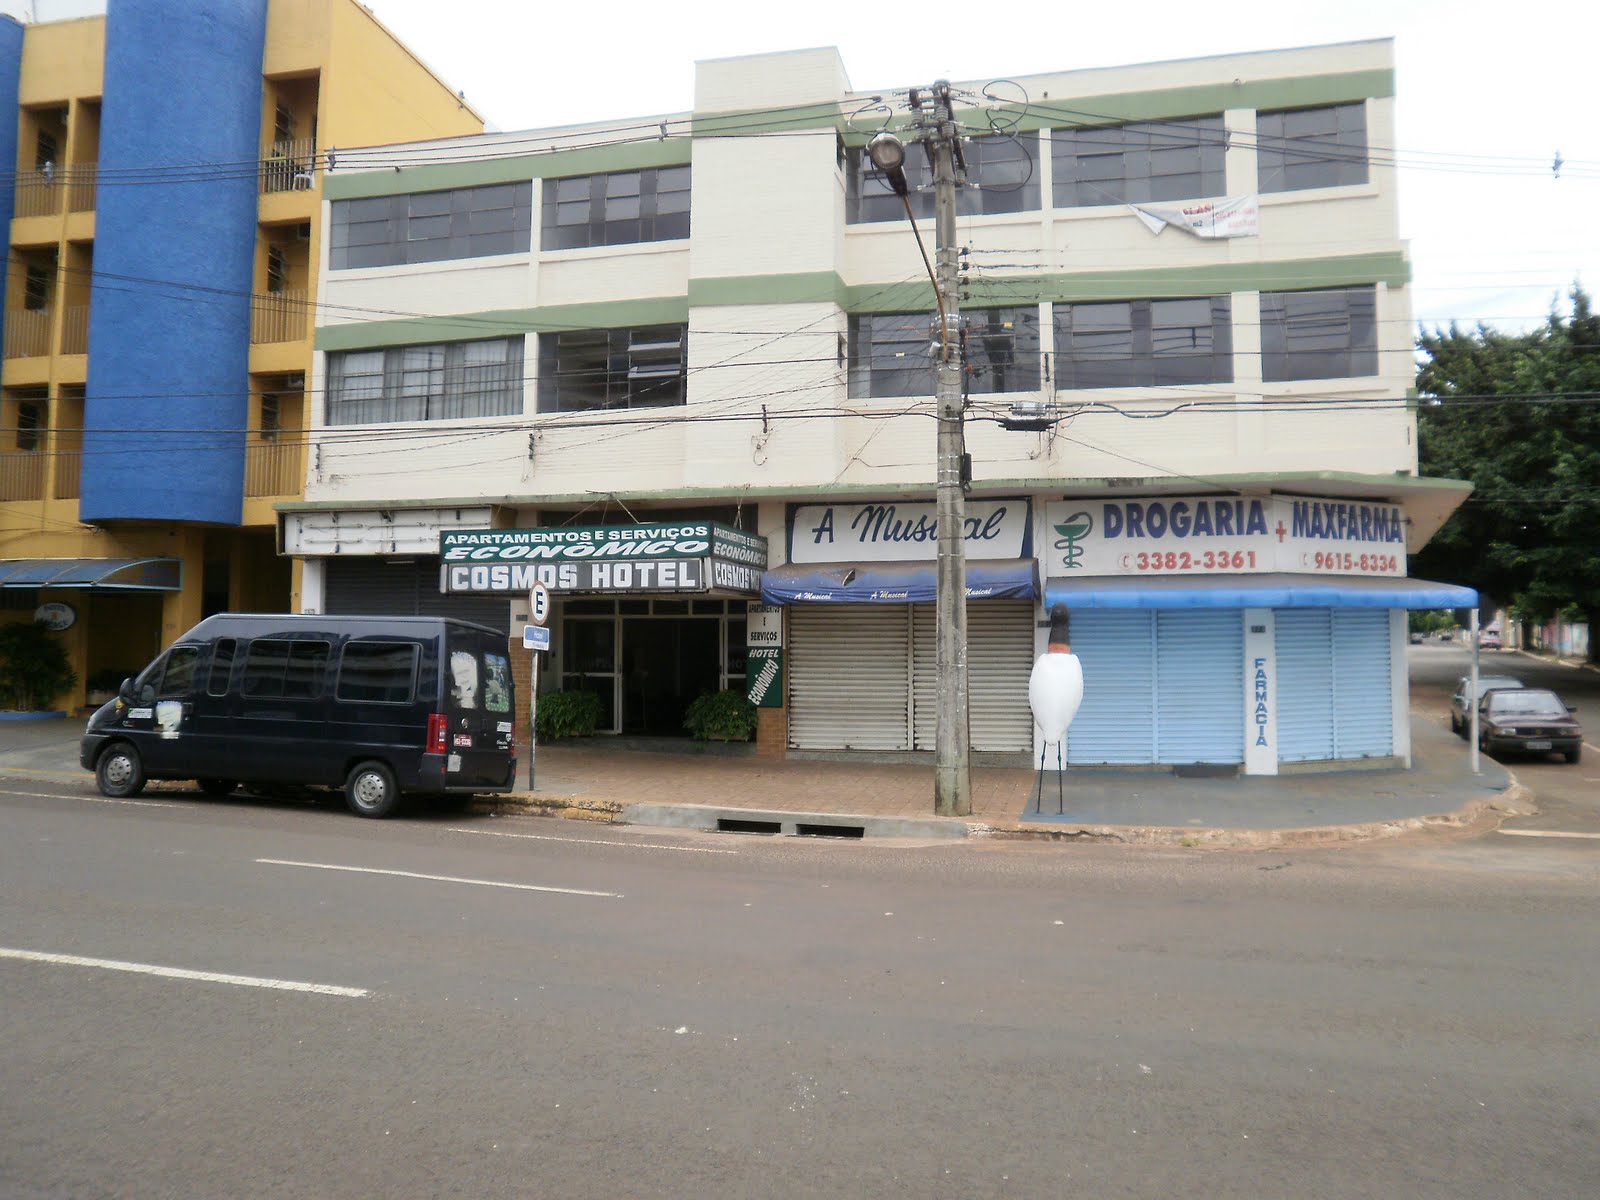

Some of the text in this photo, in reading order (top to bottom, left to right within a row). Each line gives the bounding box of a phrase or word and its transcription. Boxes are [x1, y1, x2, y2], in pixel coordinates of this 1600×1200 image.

[812, 508, 834, 544] A
[1104, 501, 1268, 539] DROGARIA
[1293, 501, 1403, 543] MAXFARMA
[445, 526, 708, 544] APARTAMENTOS E SERVIÇOS
[444, 541, 709, 560] ECONÔMICO
[1137, 551, 1256, 570] 3382-3361
[1315, 551, 1397, 572] 9615-8334
[452, 562, 696, 590] COSMOS HOTEL
[715, 562, 750, 589] COSMOS
[535, 591, 544, 615] E
[803, 592, 833, 600] Musical
[880, 590, 909, 599] Musical
[750, 631, 777, 645] SERVIÇOS
[749, 649, 779, 658] HOTEL
[1254, 658, 1268, 747] FARMACIA
